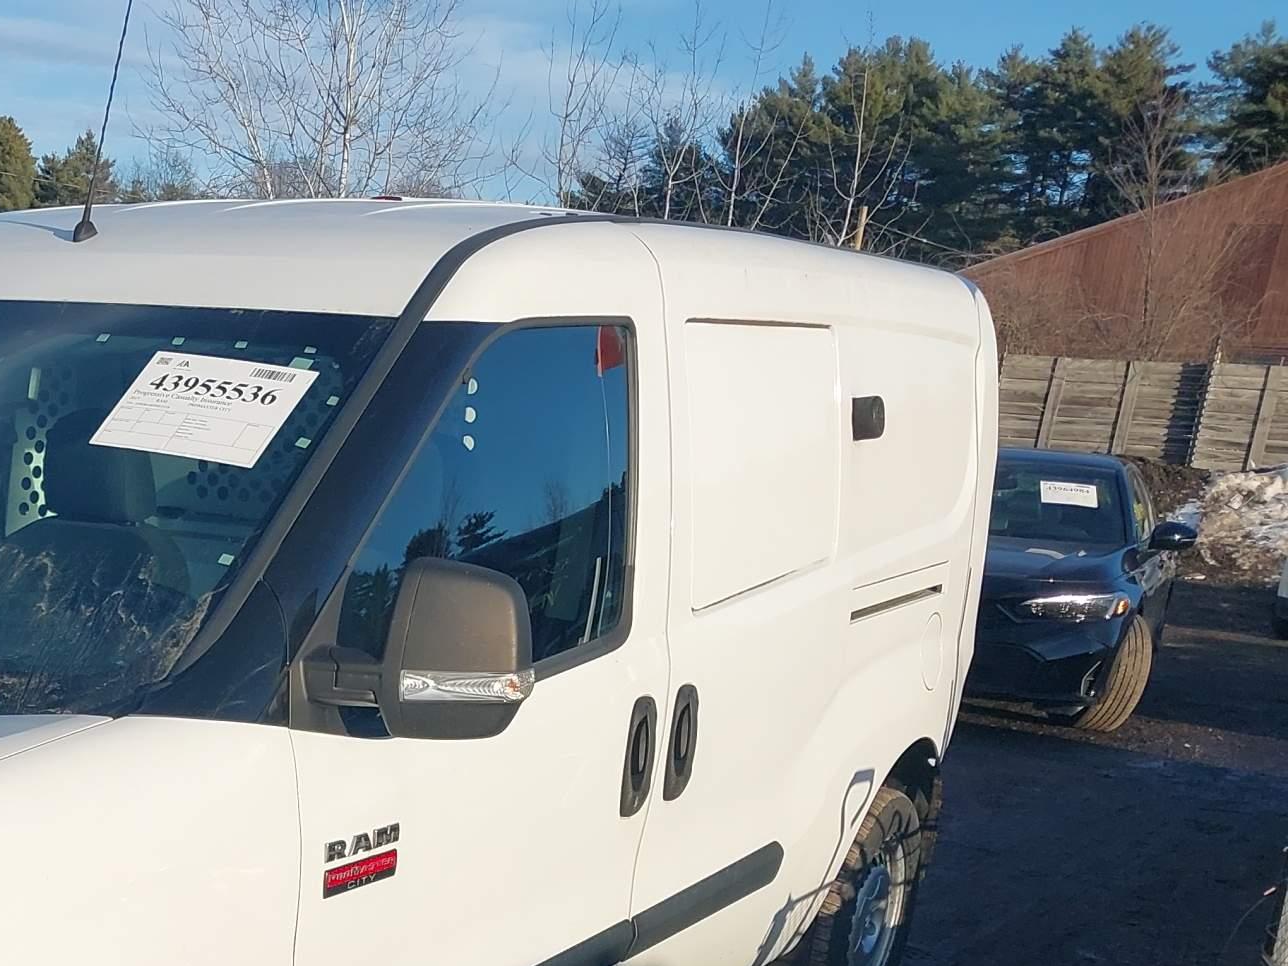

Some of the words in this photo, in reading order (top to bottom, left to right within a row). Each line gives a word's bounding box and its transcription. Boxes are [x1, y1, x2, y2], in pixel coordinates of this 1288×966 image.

[149, 373, 284, 406] 43955536
[324, 822, 400, 864] RAM
[347, 873, 377, 889] CITY
